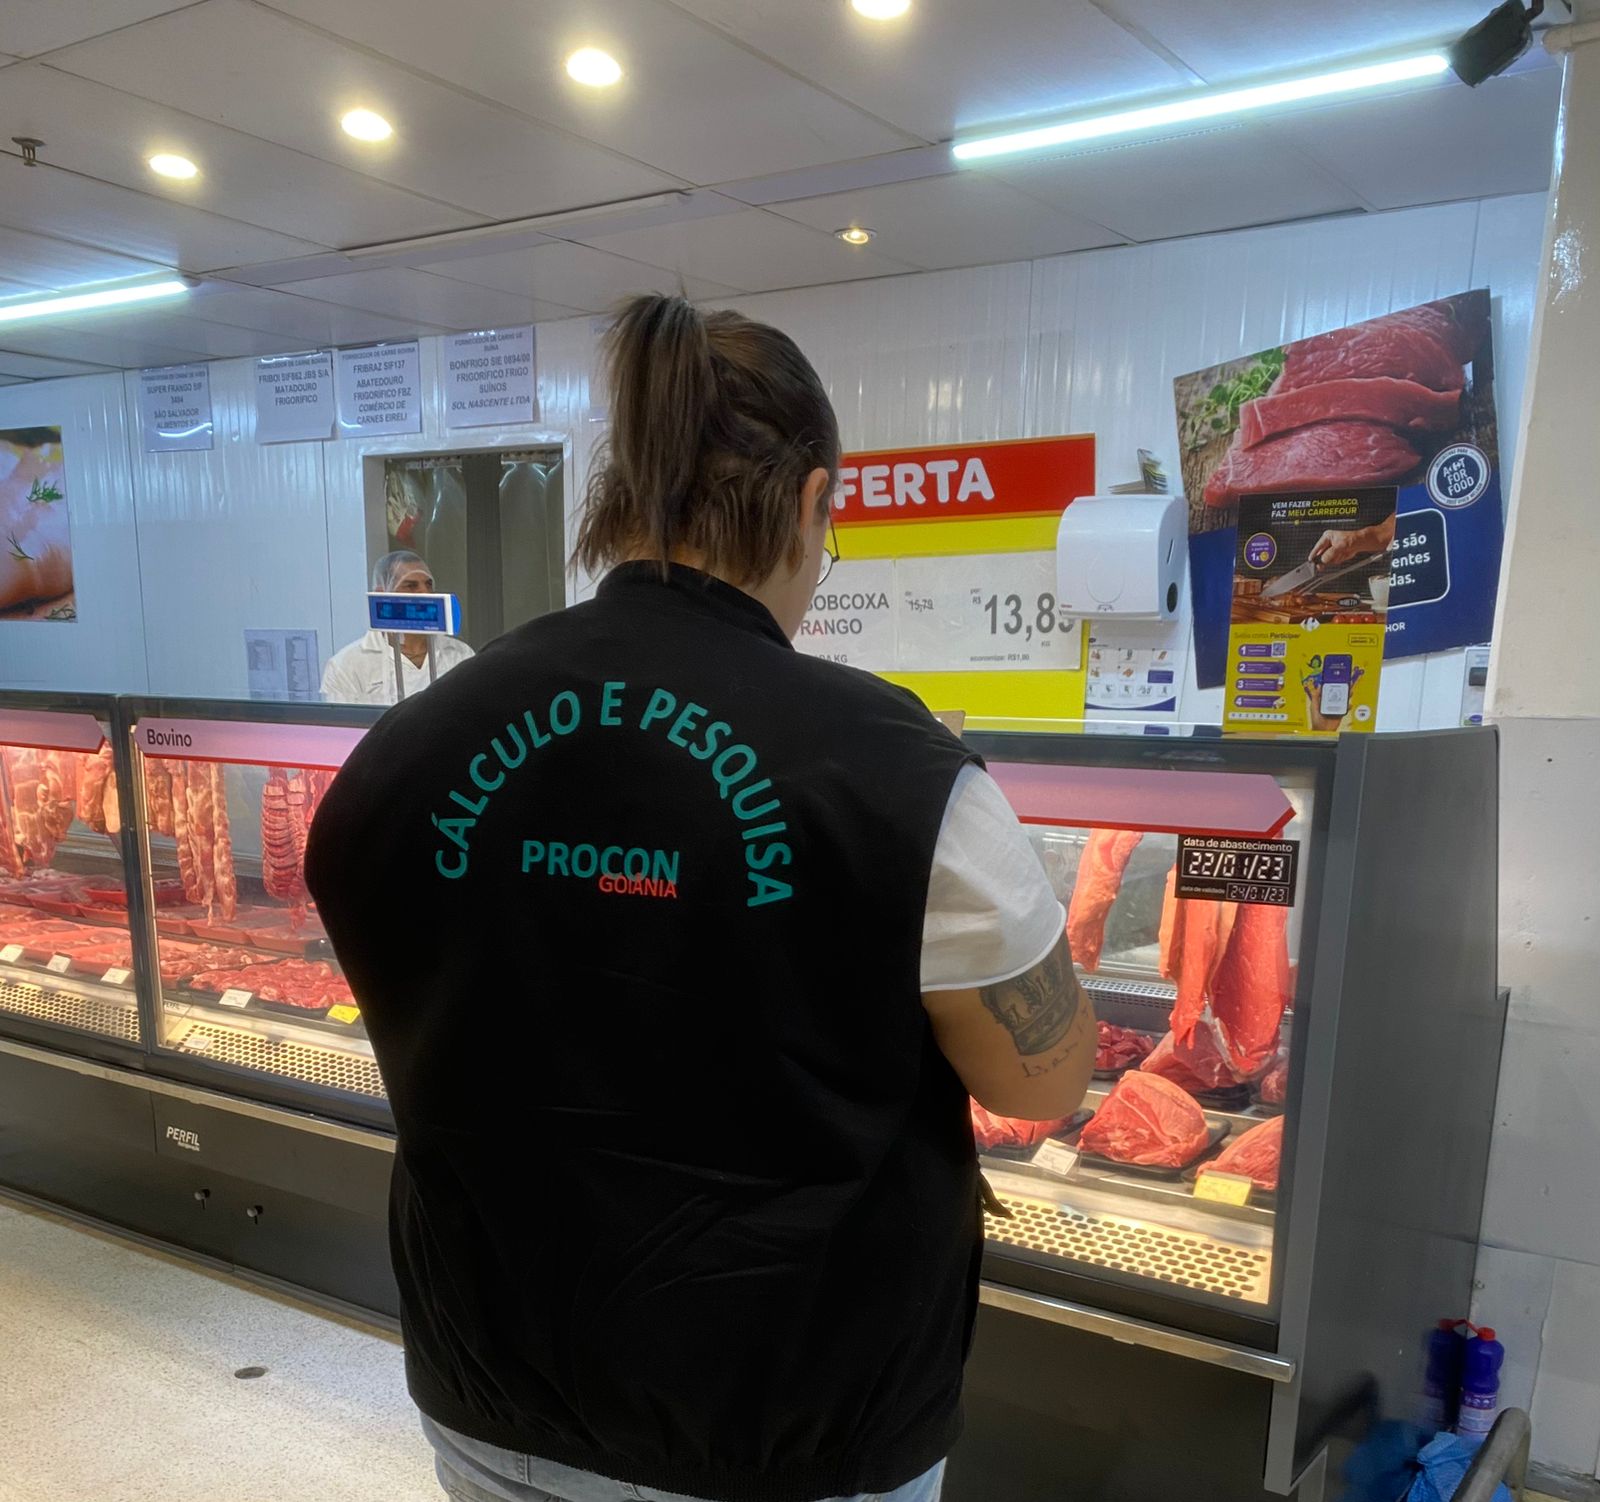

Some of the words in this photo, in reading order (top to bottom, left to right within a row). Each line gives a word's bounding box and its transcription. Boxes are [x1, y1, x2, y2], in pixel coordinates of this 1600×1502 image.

[449, 358, 489, 370] BONFRIGO
[275, 382, 317, 393] MATADOURO
[1447, 469, 1468, 485] FOR
[1448, 476, 1474, 496] FOOD
[1288, 500, 1311, 508] FAZER
[1271, 510, 1287, 518] FAZ
[1288, 509, 1306, 517] MEU
[1307, 507, 1358, 516] CARREFOUR
[1402, 533, 1427, 548] são
[1391, 552, 1431, 568] entes
[1239, 663, 1246, 672] 2
[1237, 680, 1244, 689] 3
[147, 728, 192, 747] Bovino
[431, 690, 581, 880] CÁLCULO
[599, 682, 626, 726] E
[639, 688, 793, 908] PESQUISA
[1183, 838, 1205, 847] data
[1206, 839, 1218, 847] de
[1220, 840, 1293, 852] abastecimento
[521, 840, 679, 885] PROCON
[1189, 852, 1284, 880] 22/01/23
[599, 872, 677, 898] GOIÂNIA
[1230, 885, 1285, 902] 24/01/23
[166, 1126, 200, 1147] PERFIL
